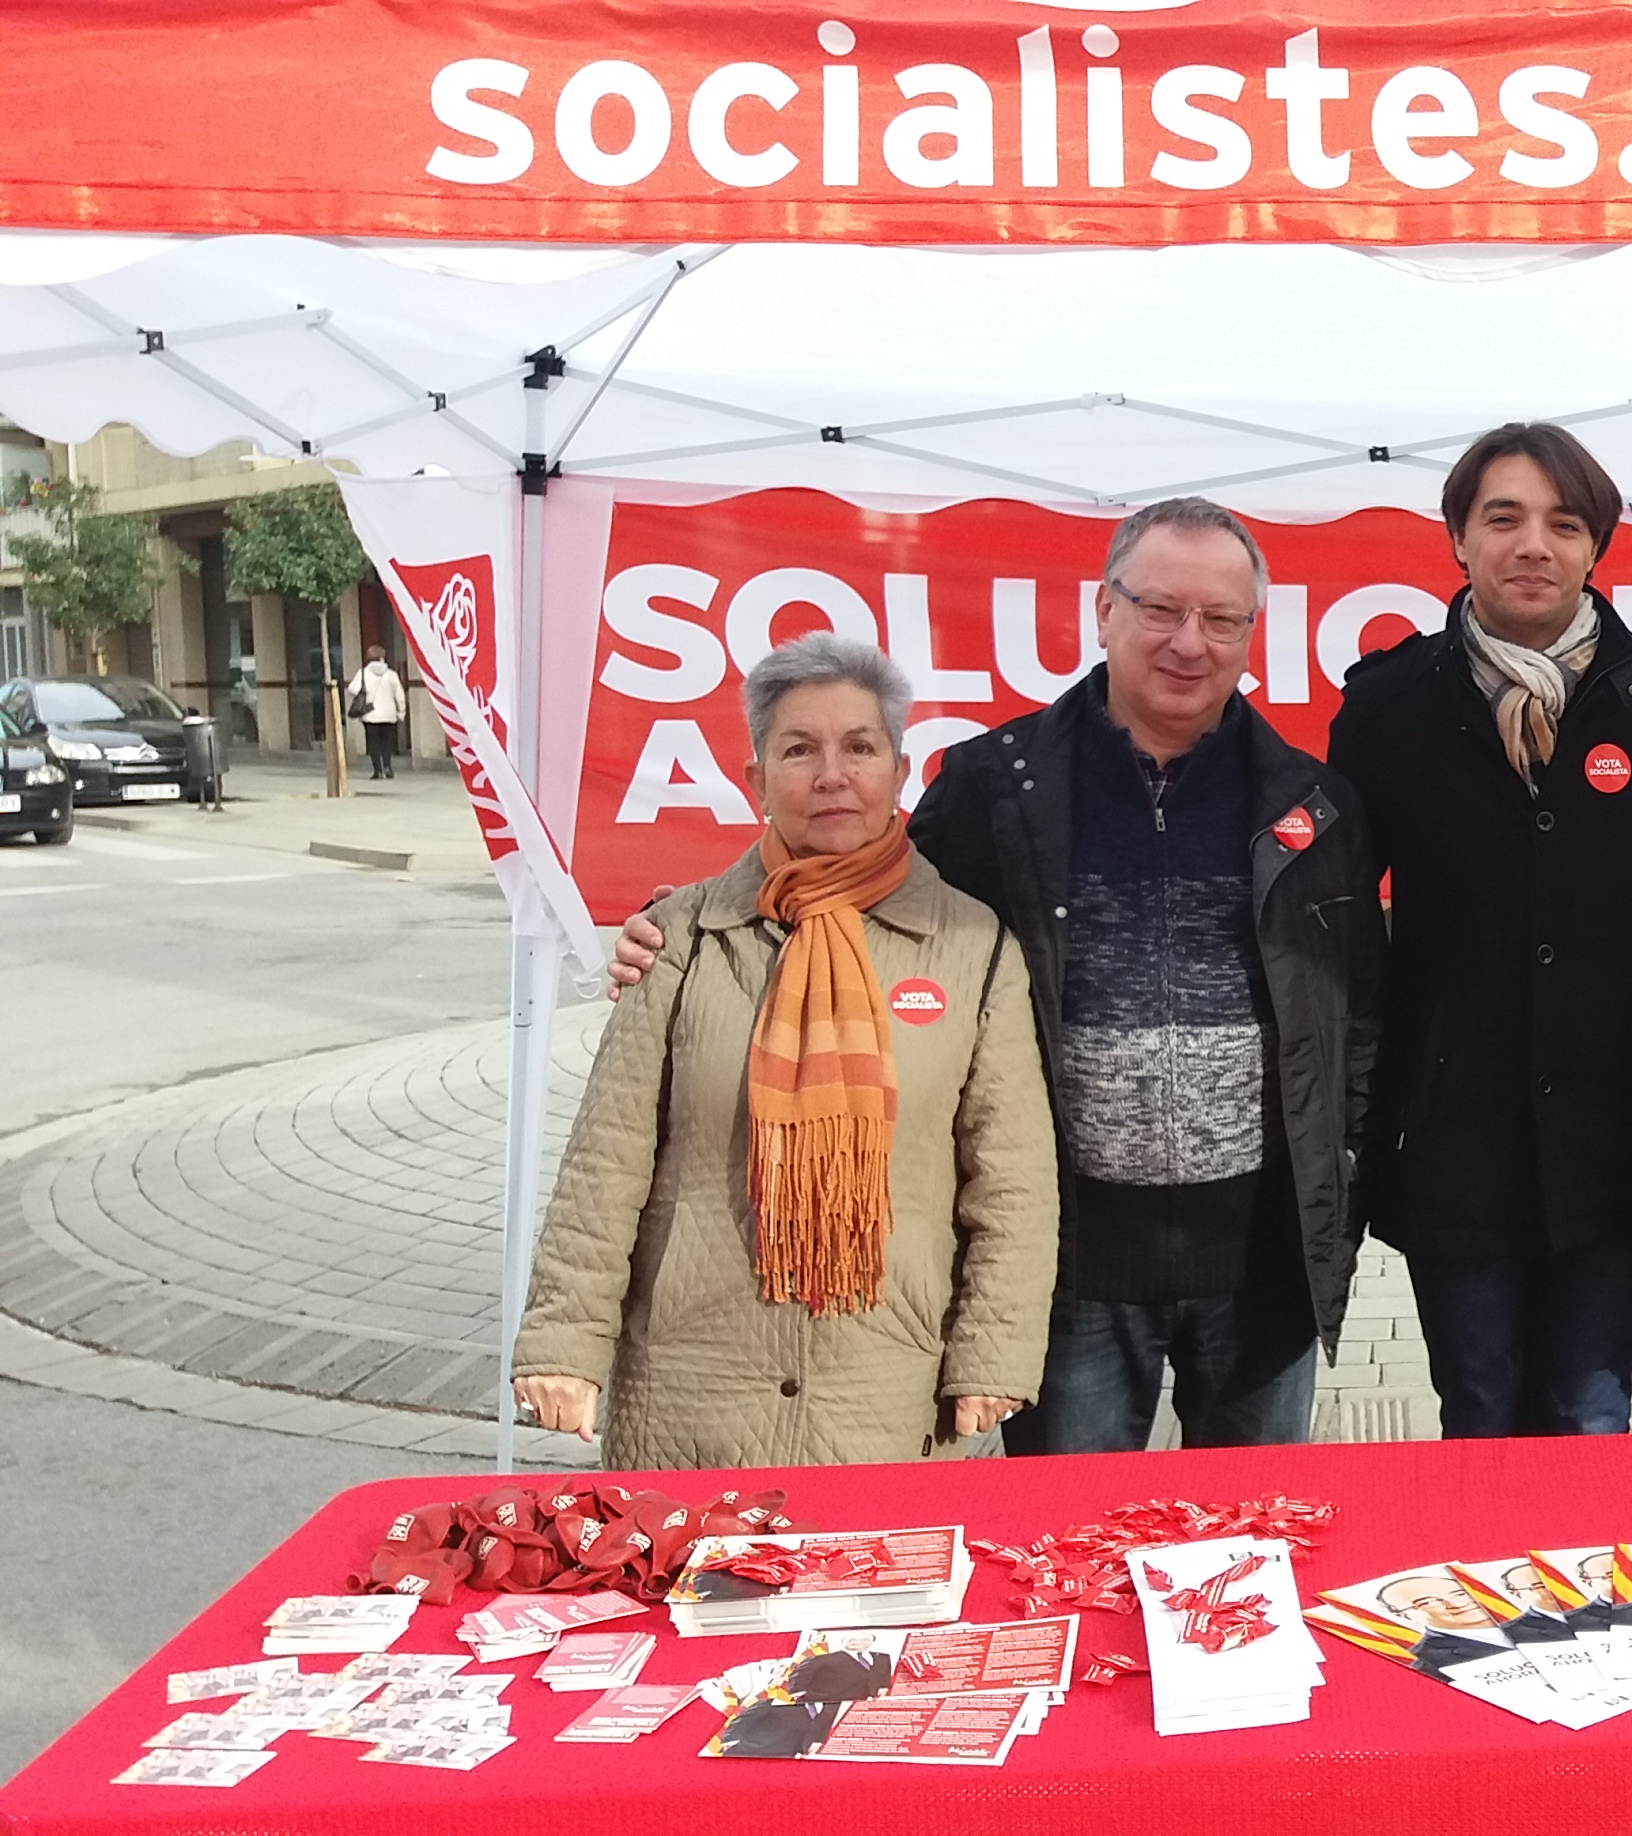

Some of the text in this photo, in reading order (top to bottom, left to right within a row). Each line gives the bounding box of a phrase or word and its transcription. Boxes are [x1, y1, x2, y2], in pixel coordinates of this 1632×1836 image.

[1594, 759, 1622, 768] VOTA
[1588, 768, 1628, 776] SOCIALISTA
[900, 992, 936, 1002] VOTA
[892, 1001, 944, 1010] SOCIALISTA
